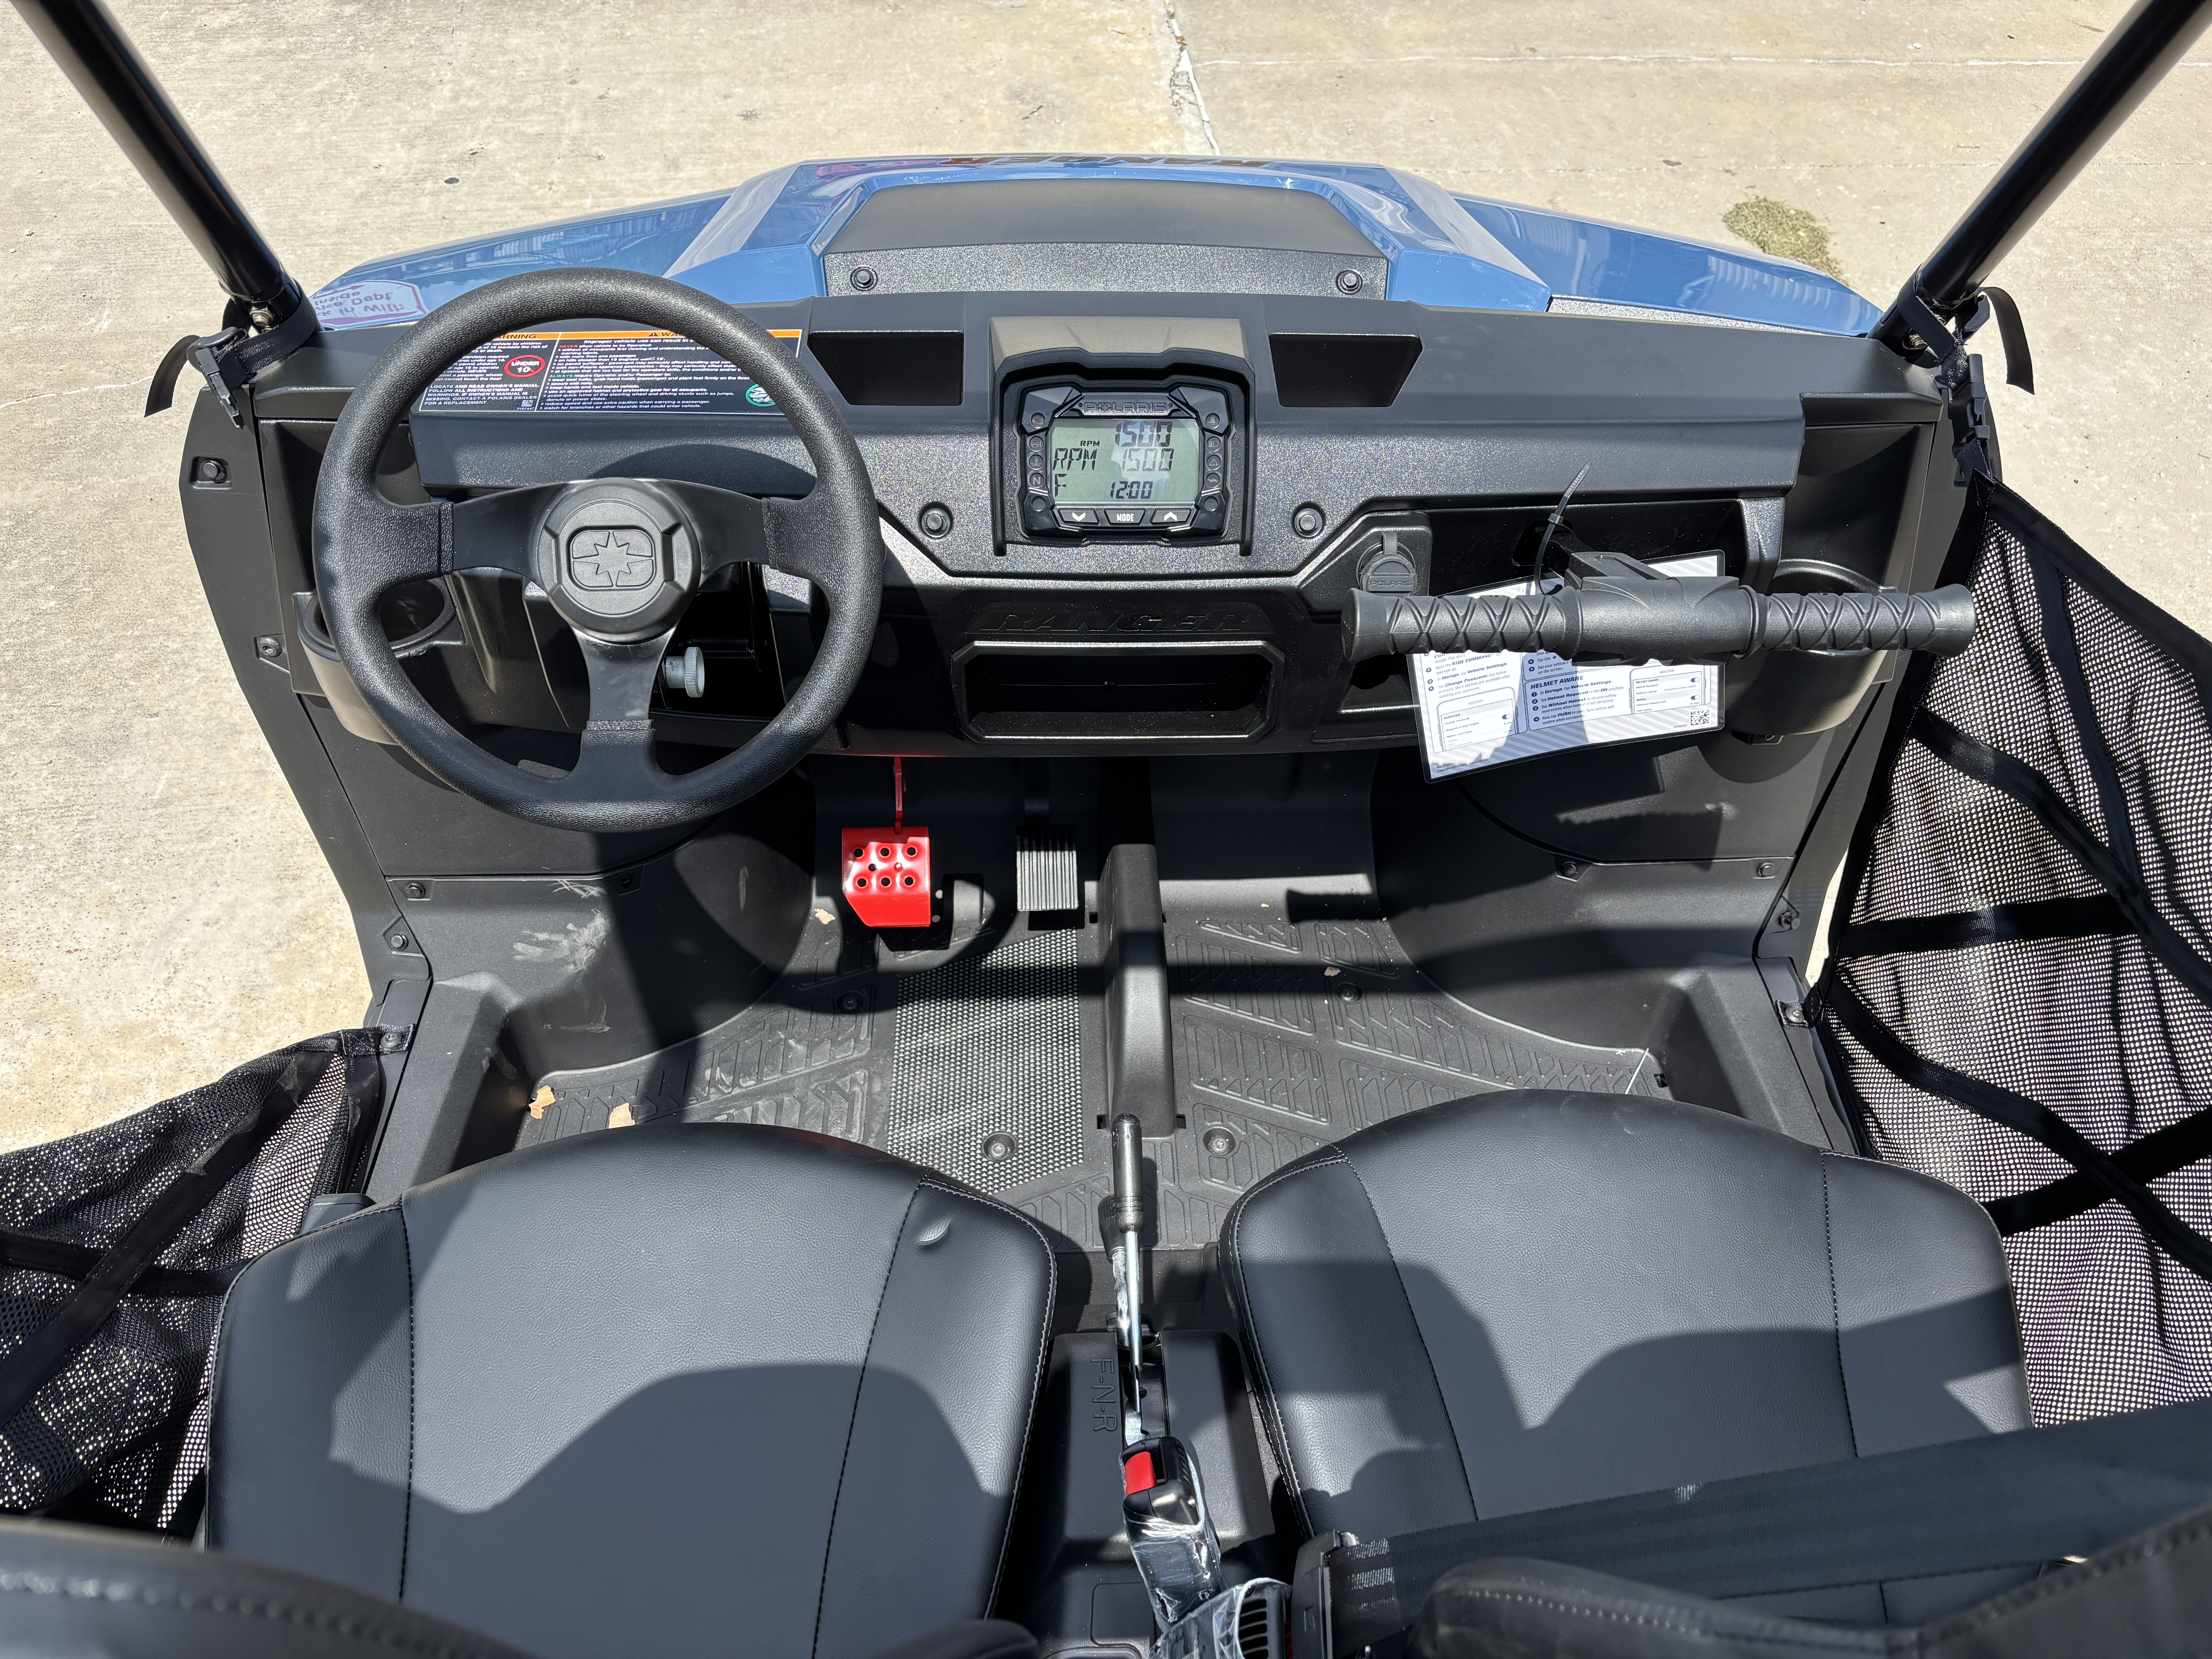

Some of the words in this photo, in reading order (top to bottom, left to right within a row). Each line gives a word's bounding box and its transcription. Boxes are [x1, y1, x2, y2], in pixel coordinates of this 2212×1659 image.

[1084, 402, 1166, 413] POLARIS
[1115, 421, 1173, 447] 1500
[1053, 448, 1097, 471] RPM
[1122, 448, 1174, 471] 1500
[1033, 477, 1041, 485] N
[1055, 474, 1067, 497] F
[1110, 481, 1153, 499] 12:00
[1116, 514, 1134, 522] MODE
[979, 613, 1251, 631] RANGER
[1531, 680, 1558, 689] HELMET
[1559, 675, 1584, 684] AWARE
[1091, 1358, 1118, 1431] F-N-R
